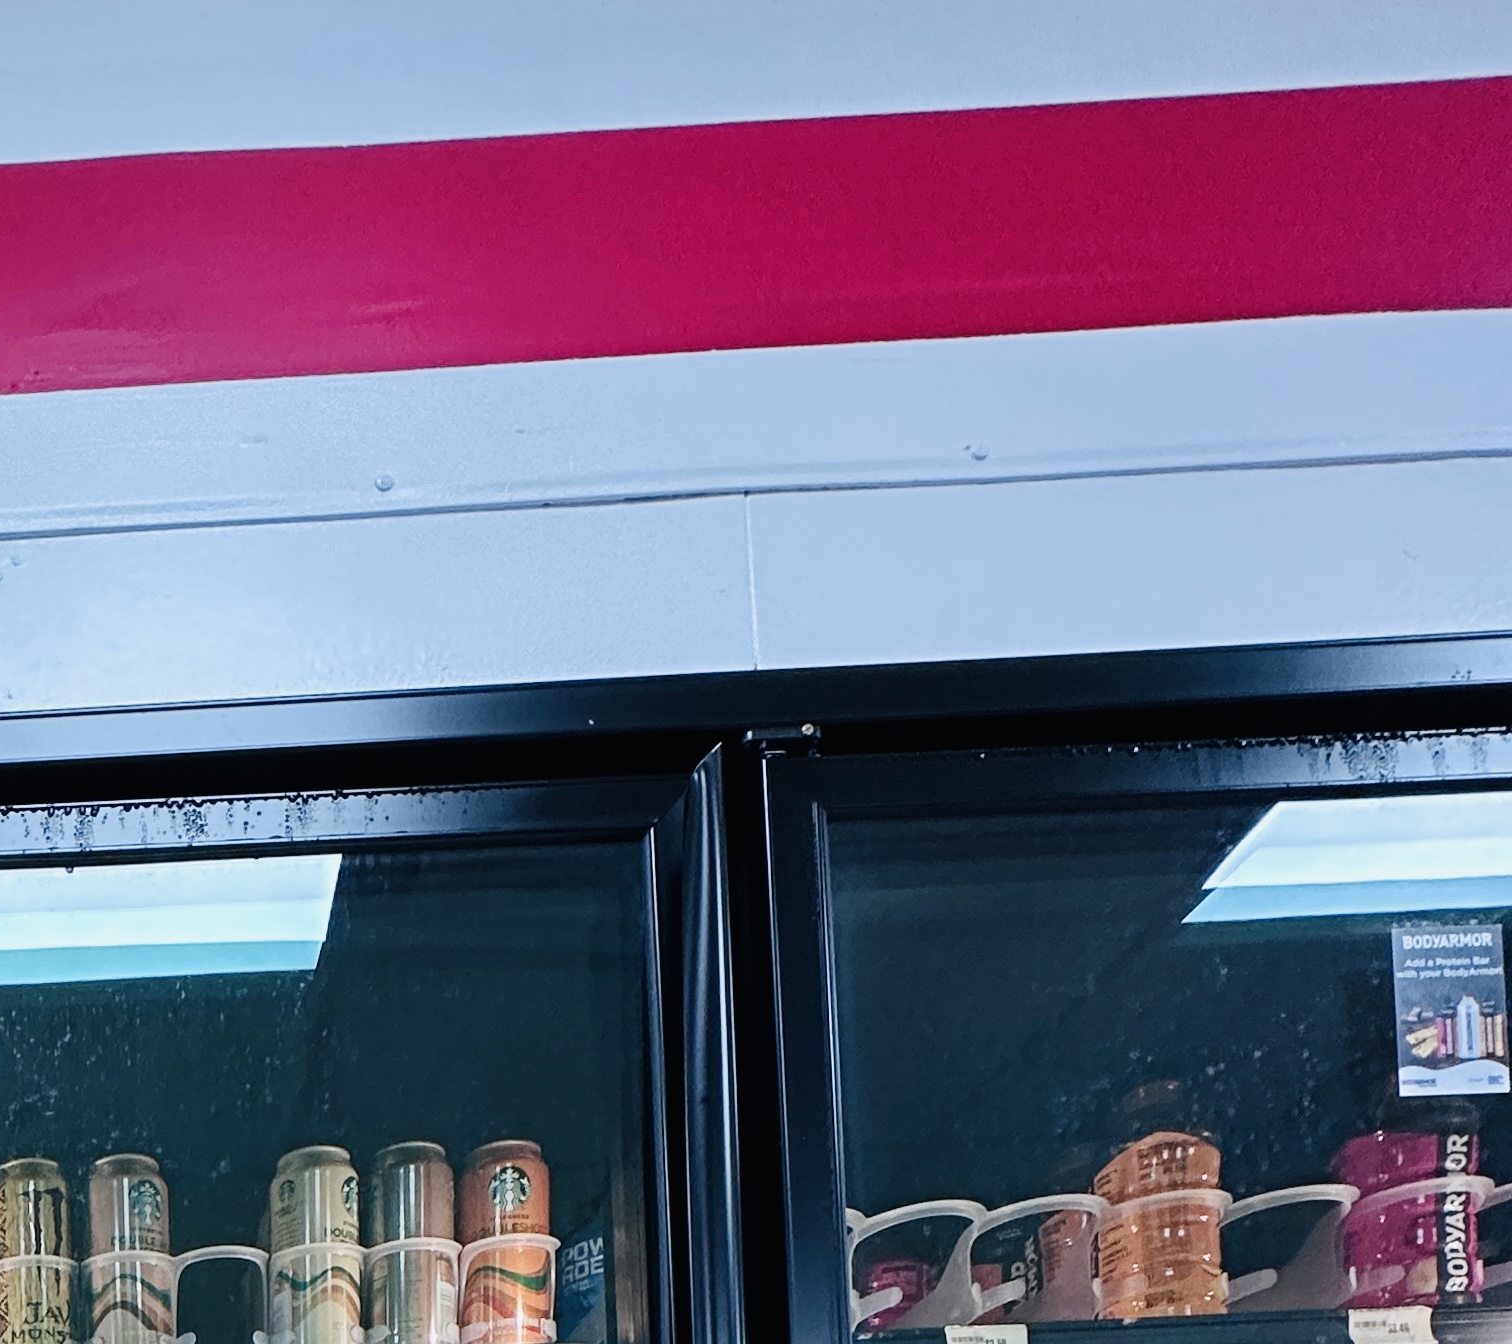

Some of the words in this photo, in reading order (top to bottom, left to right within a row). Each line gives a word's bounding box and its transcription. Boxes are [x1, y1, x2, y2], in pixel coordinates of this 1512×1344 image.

[1402, 932, 1493, 950] BODYARMOR
[1404, 958, 1427, 968] Add
[1435, 957, 1472, 968] Protein
[1473, 956, 1491, 967] Bar
[1397, 968, 1418, 979] with
[1419, 969, 1442, 980] your
[1445, 1133, 1470, 1292] BODYAROR
